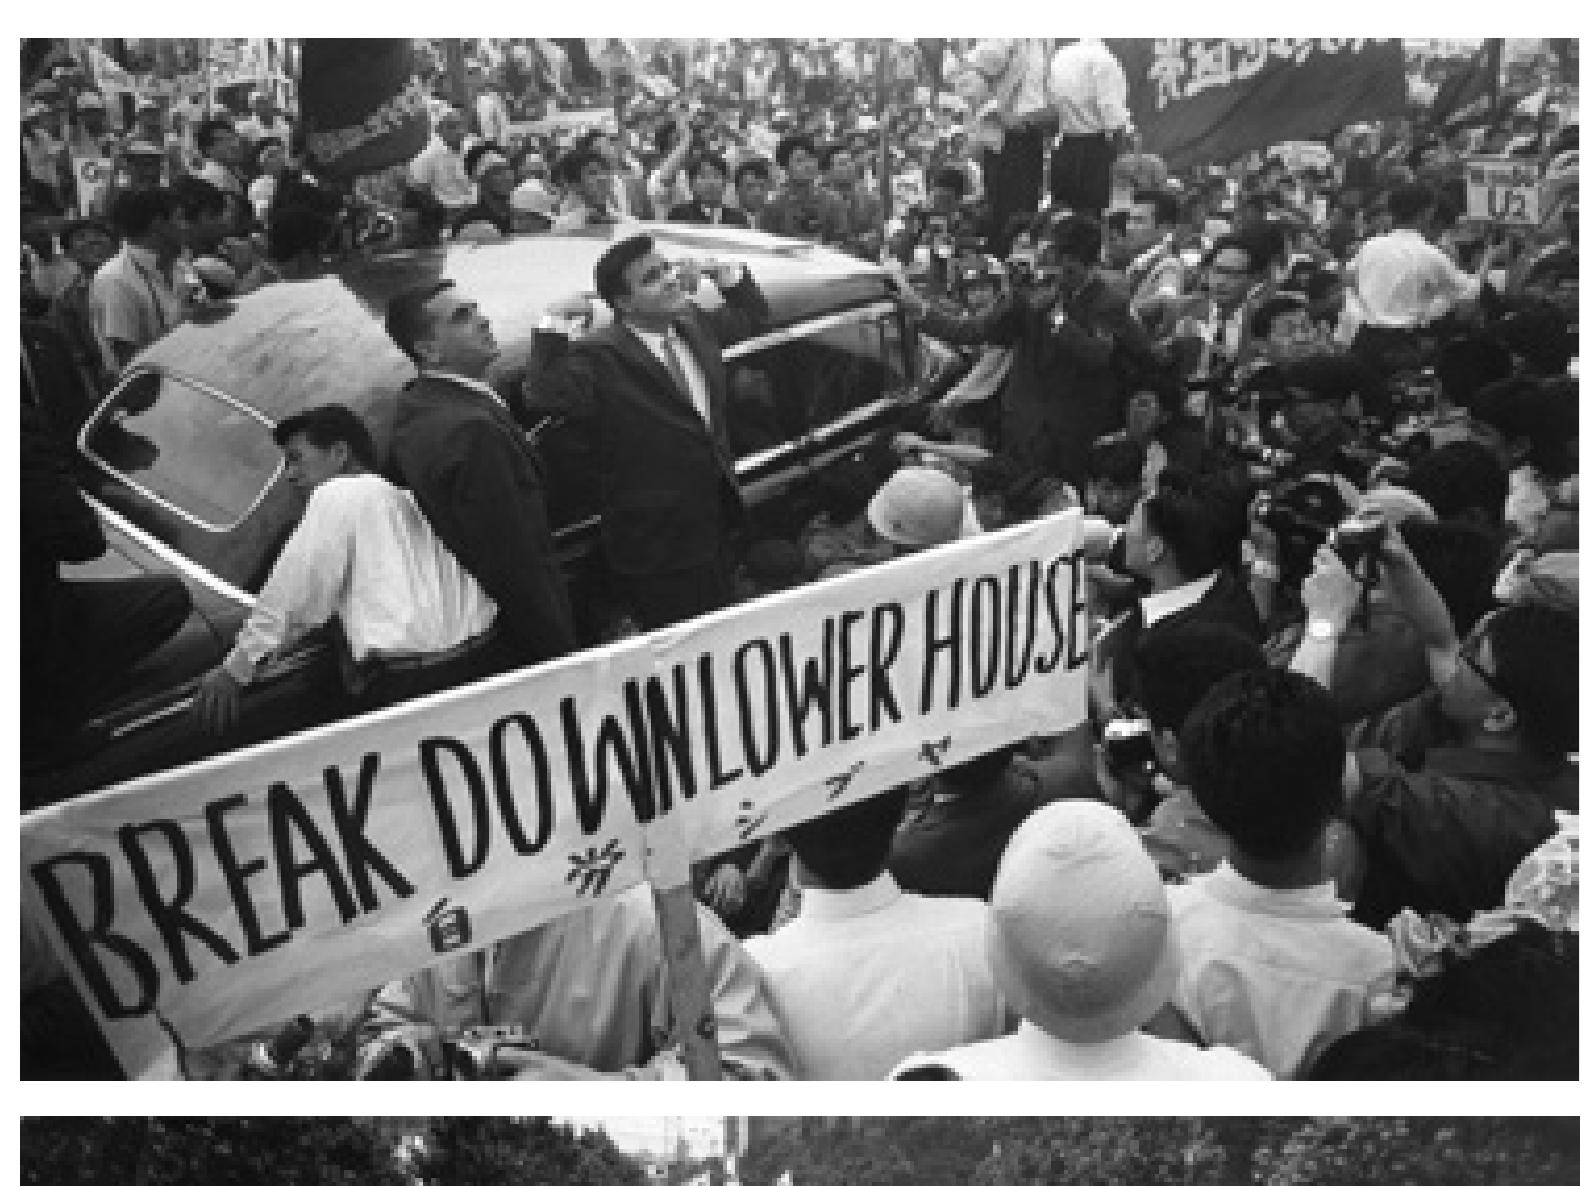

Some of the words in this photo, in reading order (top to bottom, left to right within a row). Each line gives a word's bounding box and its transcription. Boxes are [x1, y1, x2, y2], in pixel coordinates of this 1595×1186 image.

[30, 751, 415, 1019] BREAK
[418, 664, 698, 881] DOWN
[697, 600, 905, 790] LOWER
[920, 549, 1089, 715] HOUSE
